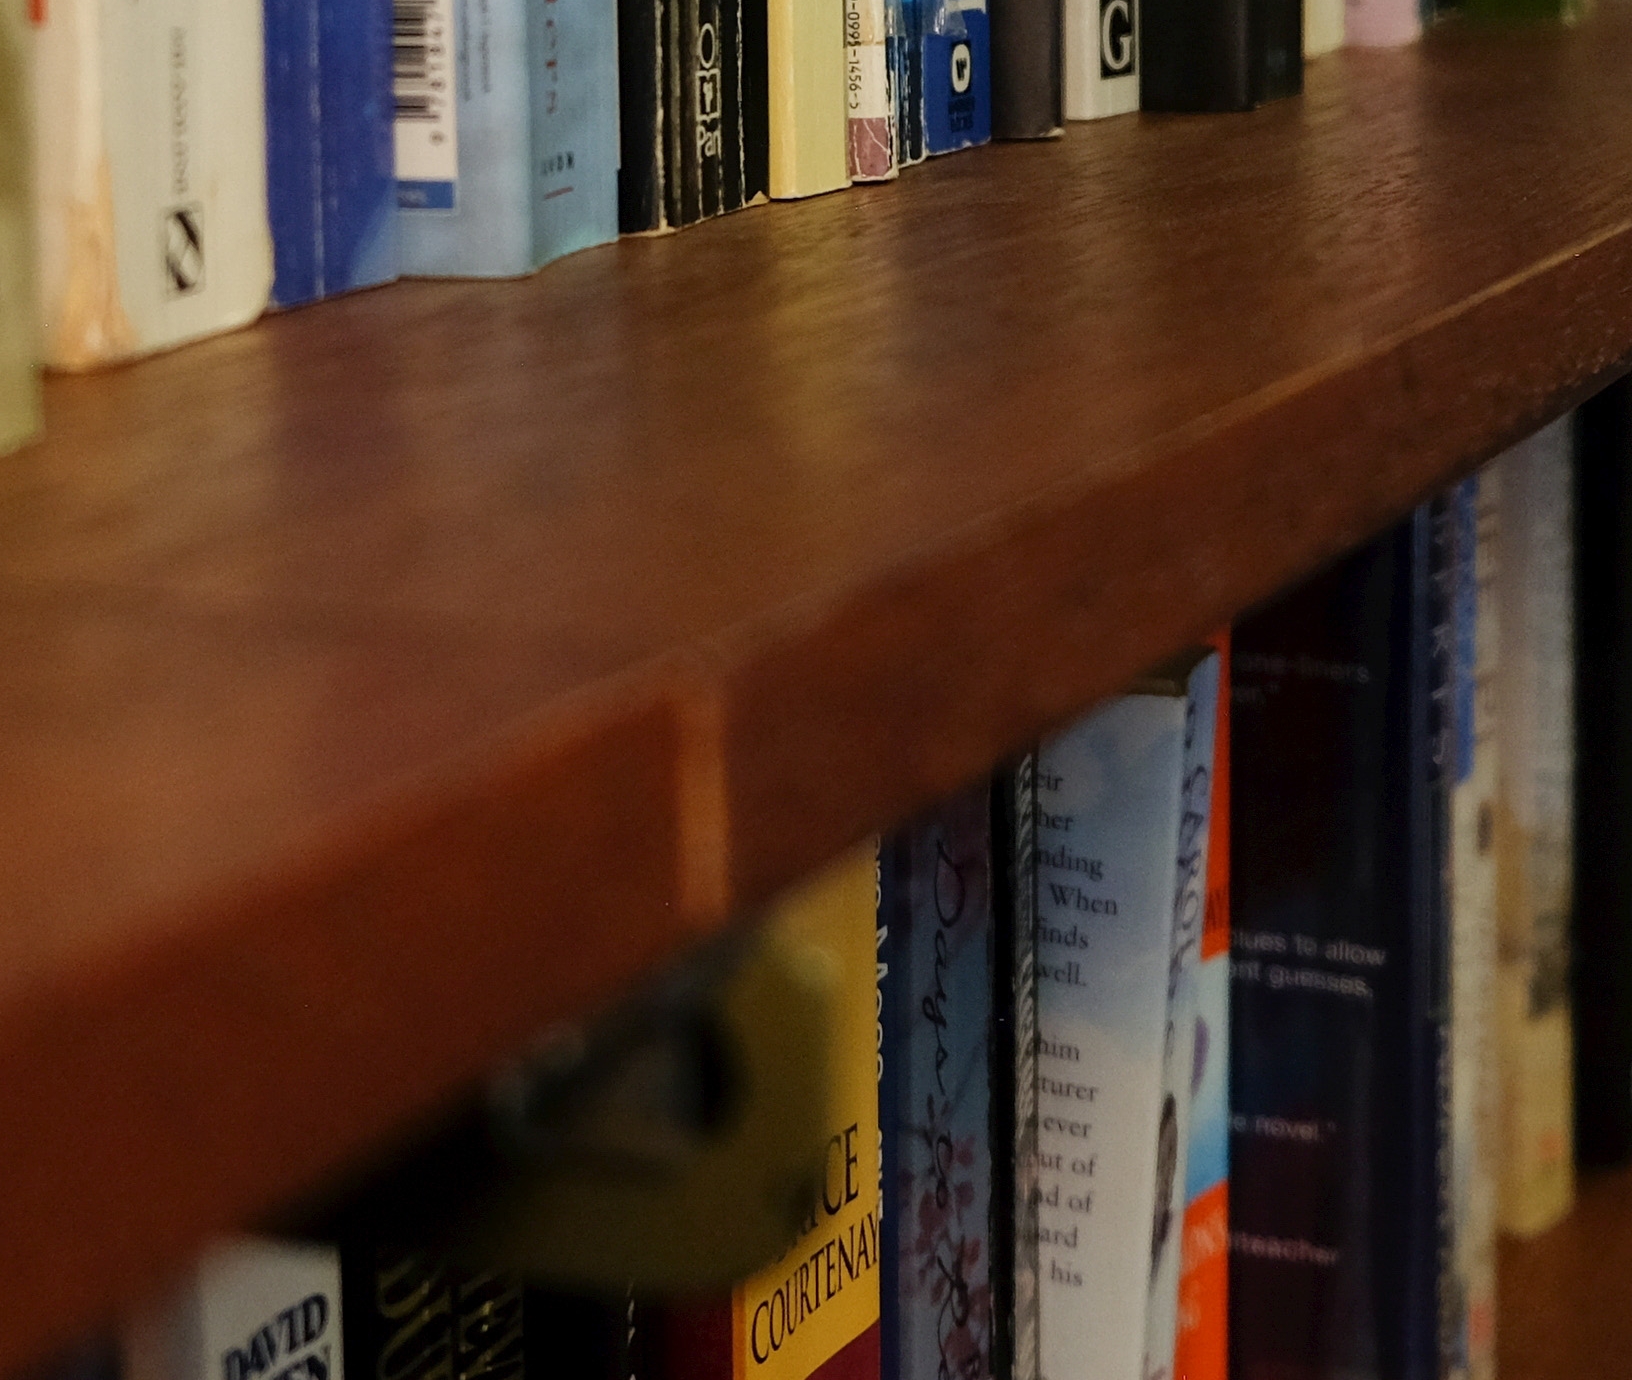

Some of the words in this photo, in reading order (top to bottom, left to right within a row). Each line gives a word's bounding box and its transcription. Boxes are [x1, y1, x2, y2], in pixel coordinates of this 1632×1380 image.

[1048, 883, 1118, 916] When
[1294, 932, 1318, 955] to
[1324, 940, 1386, 967] allow
[1267, 964, 1374, 998] guesses.
[1070, 1153, 1097, 1178] of
[1068, 1193, 1092, 1213] of
[750, 1205, 880, 1365] COURTENAY
[223, 1291, 329, 1380] DAVID
